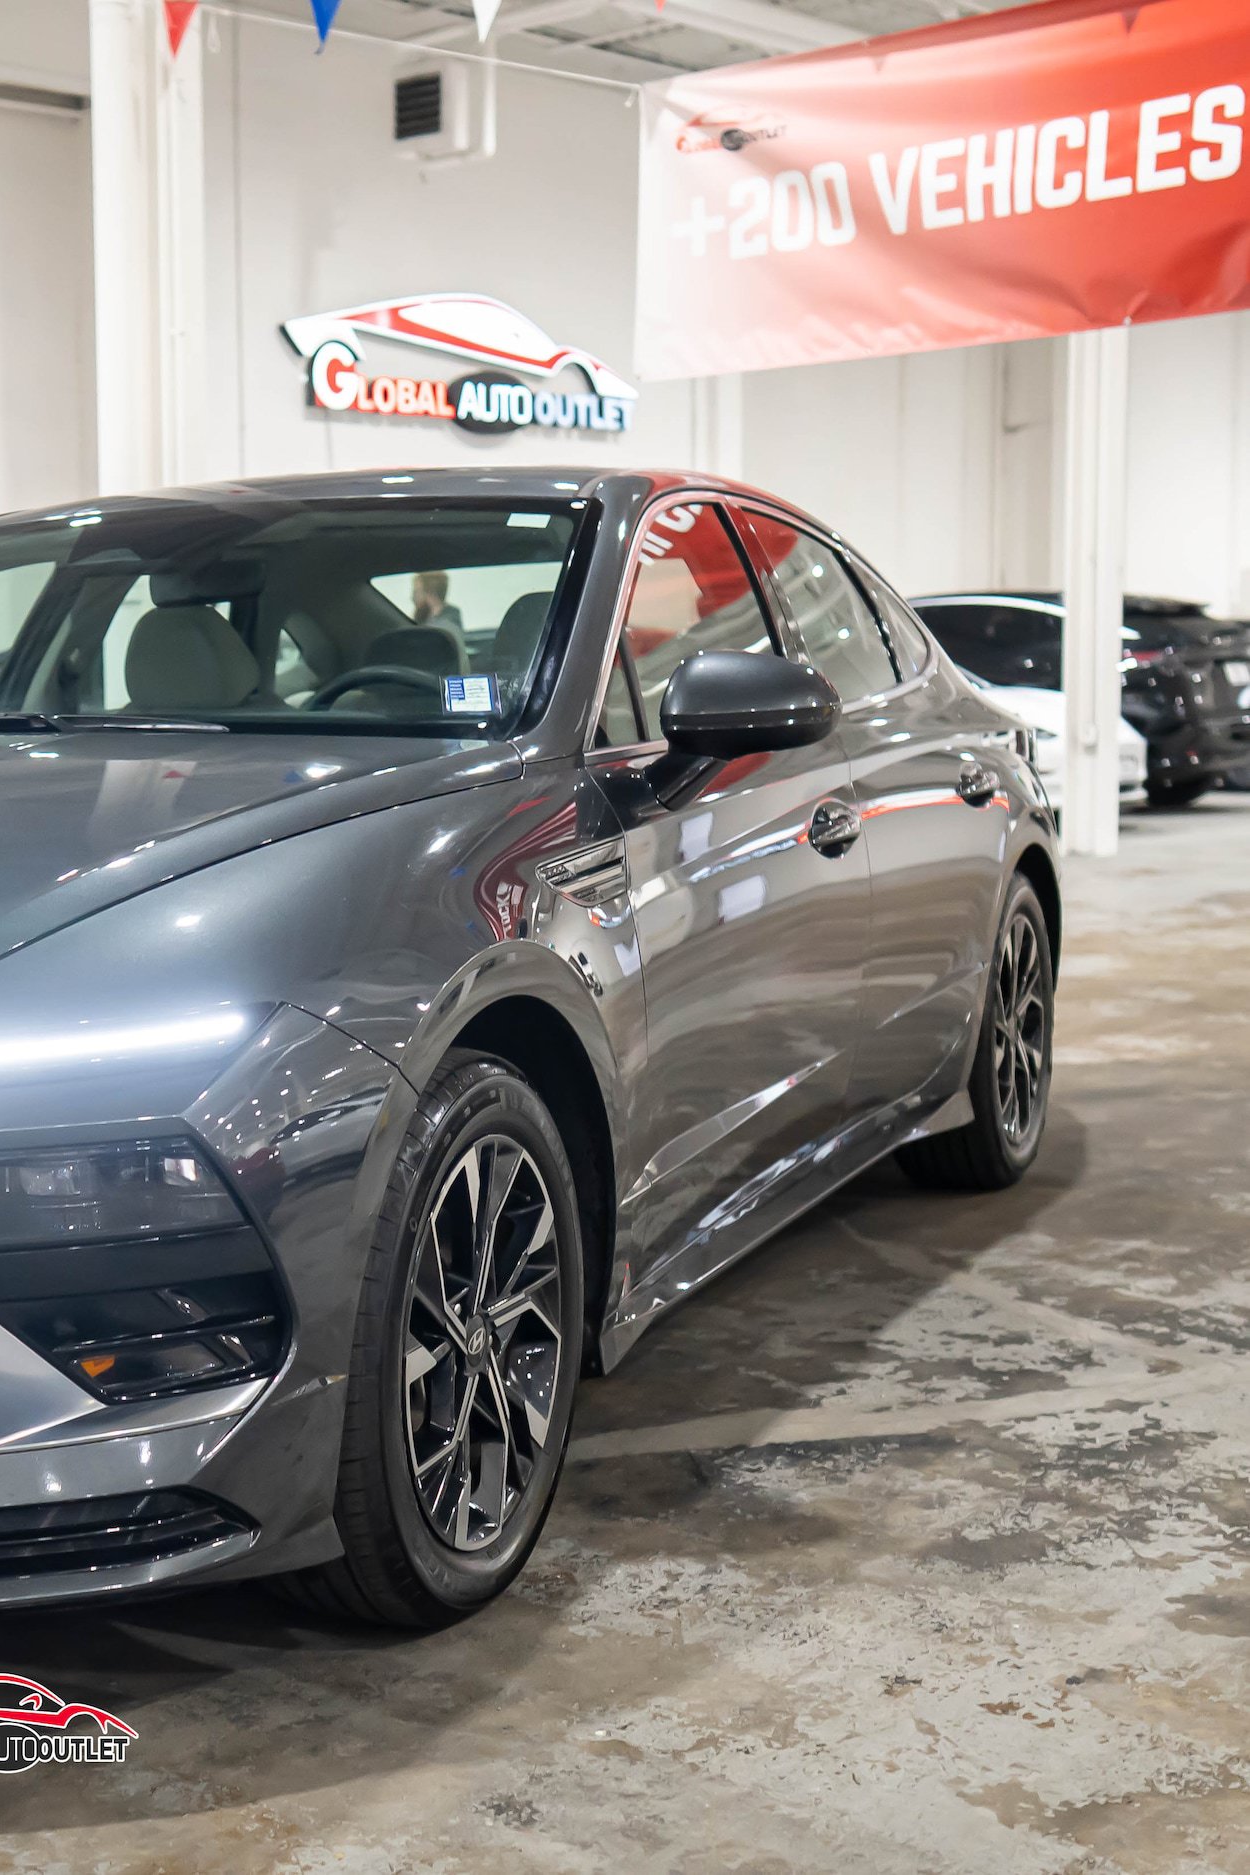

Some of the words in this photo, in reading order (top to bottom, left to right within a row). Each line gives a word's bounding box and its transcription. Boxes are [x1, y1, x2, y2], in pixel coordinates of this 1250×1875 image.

[672, 160, 857, 259] +200
[868, 84, 1246, 236] VEHICLES
[312, 341, 455, 419] GLOBAL
[457, 380, 534, 426] AUTO
[534, 391, 636, 432] OUTLET
